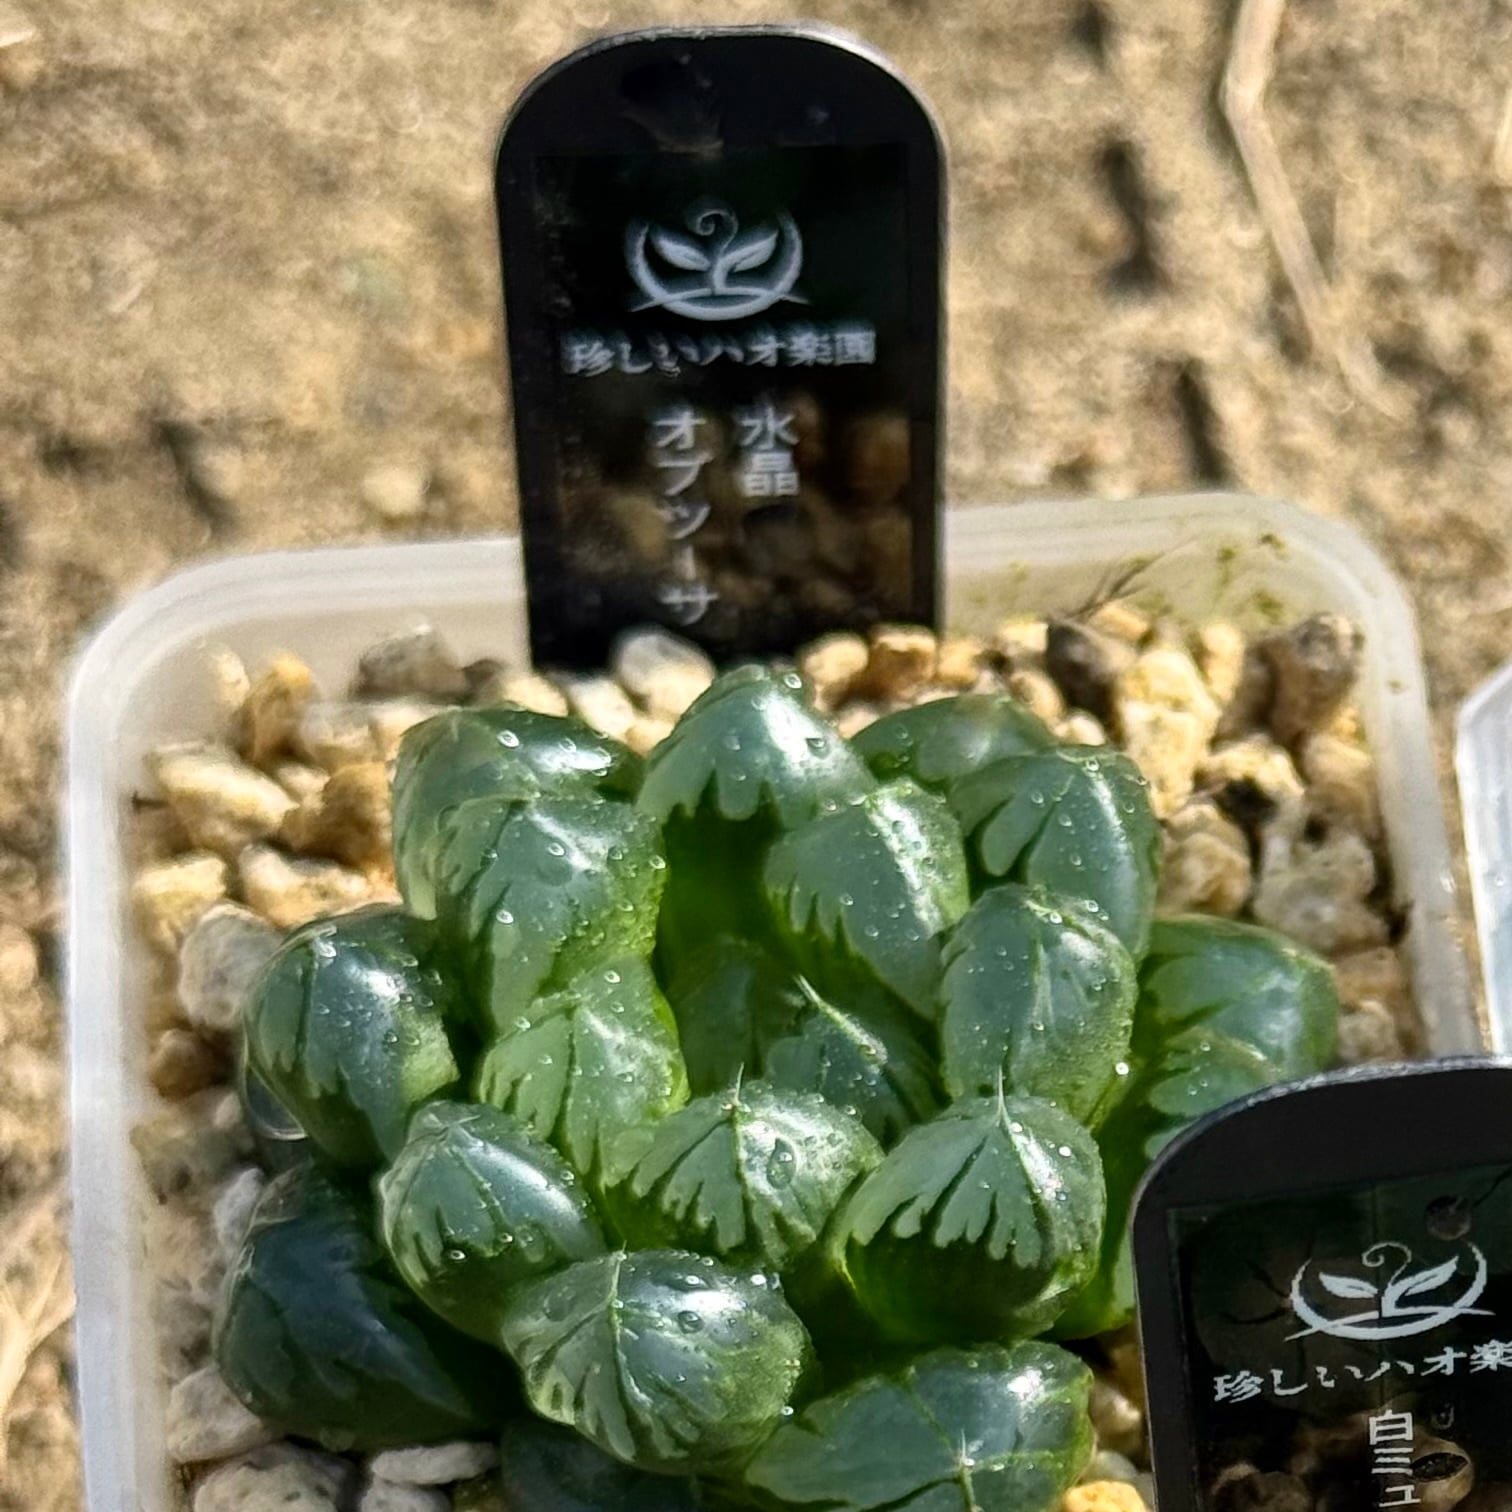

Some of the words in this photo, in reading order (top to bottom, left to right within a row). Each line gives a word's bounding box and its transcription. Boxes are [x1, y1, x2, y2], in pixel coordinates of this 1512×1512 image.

[653, 409, 720, 626] オブツーサ
[740, 406, 801, 497] 水晶
